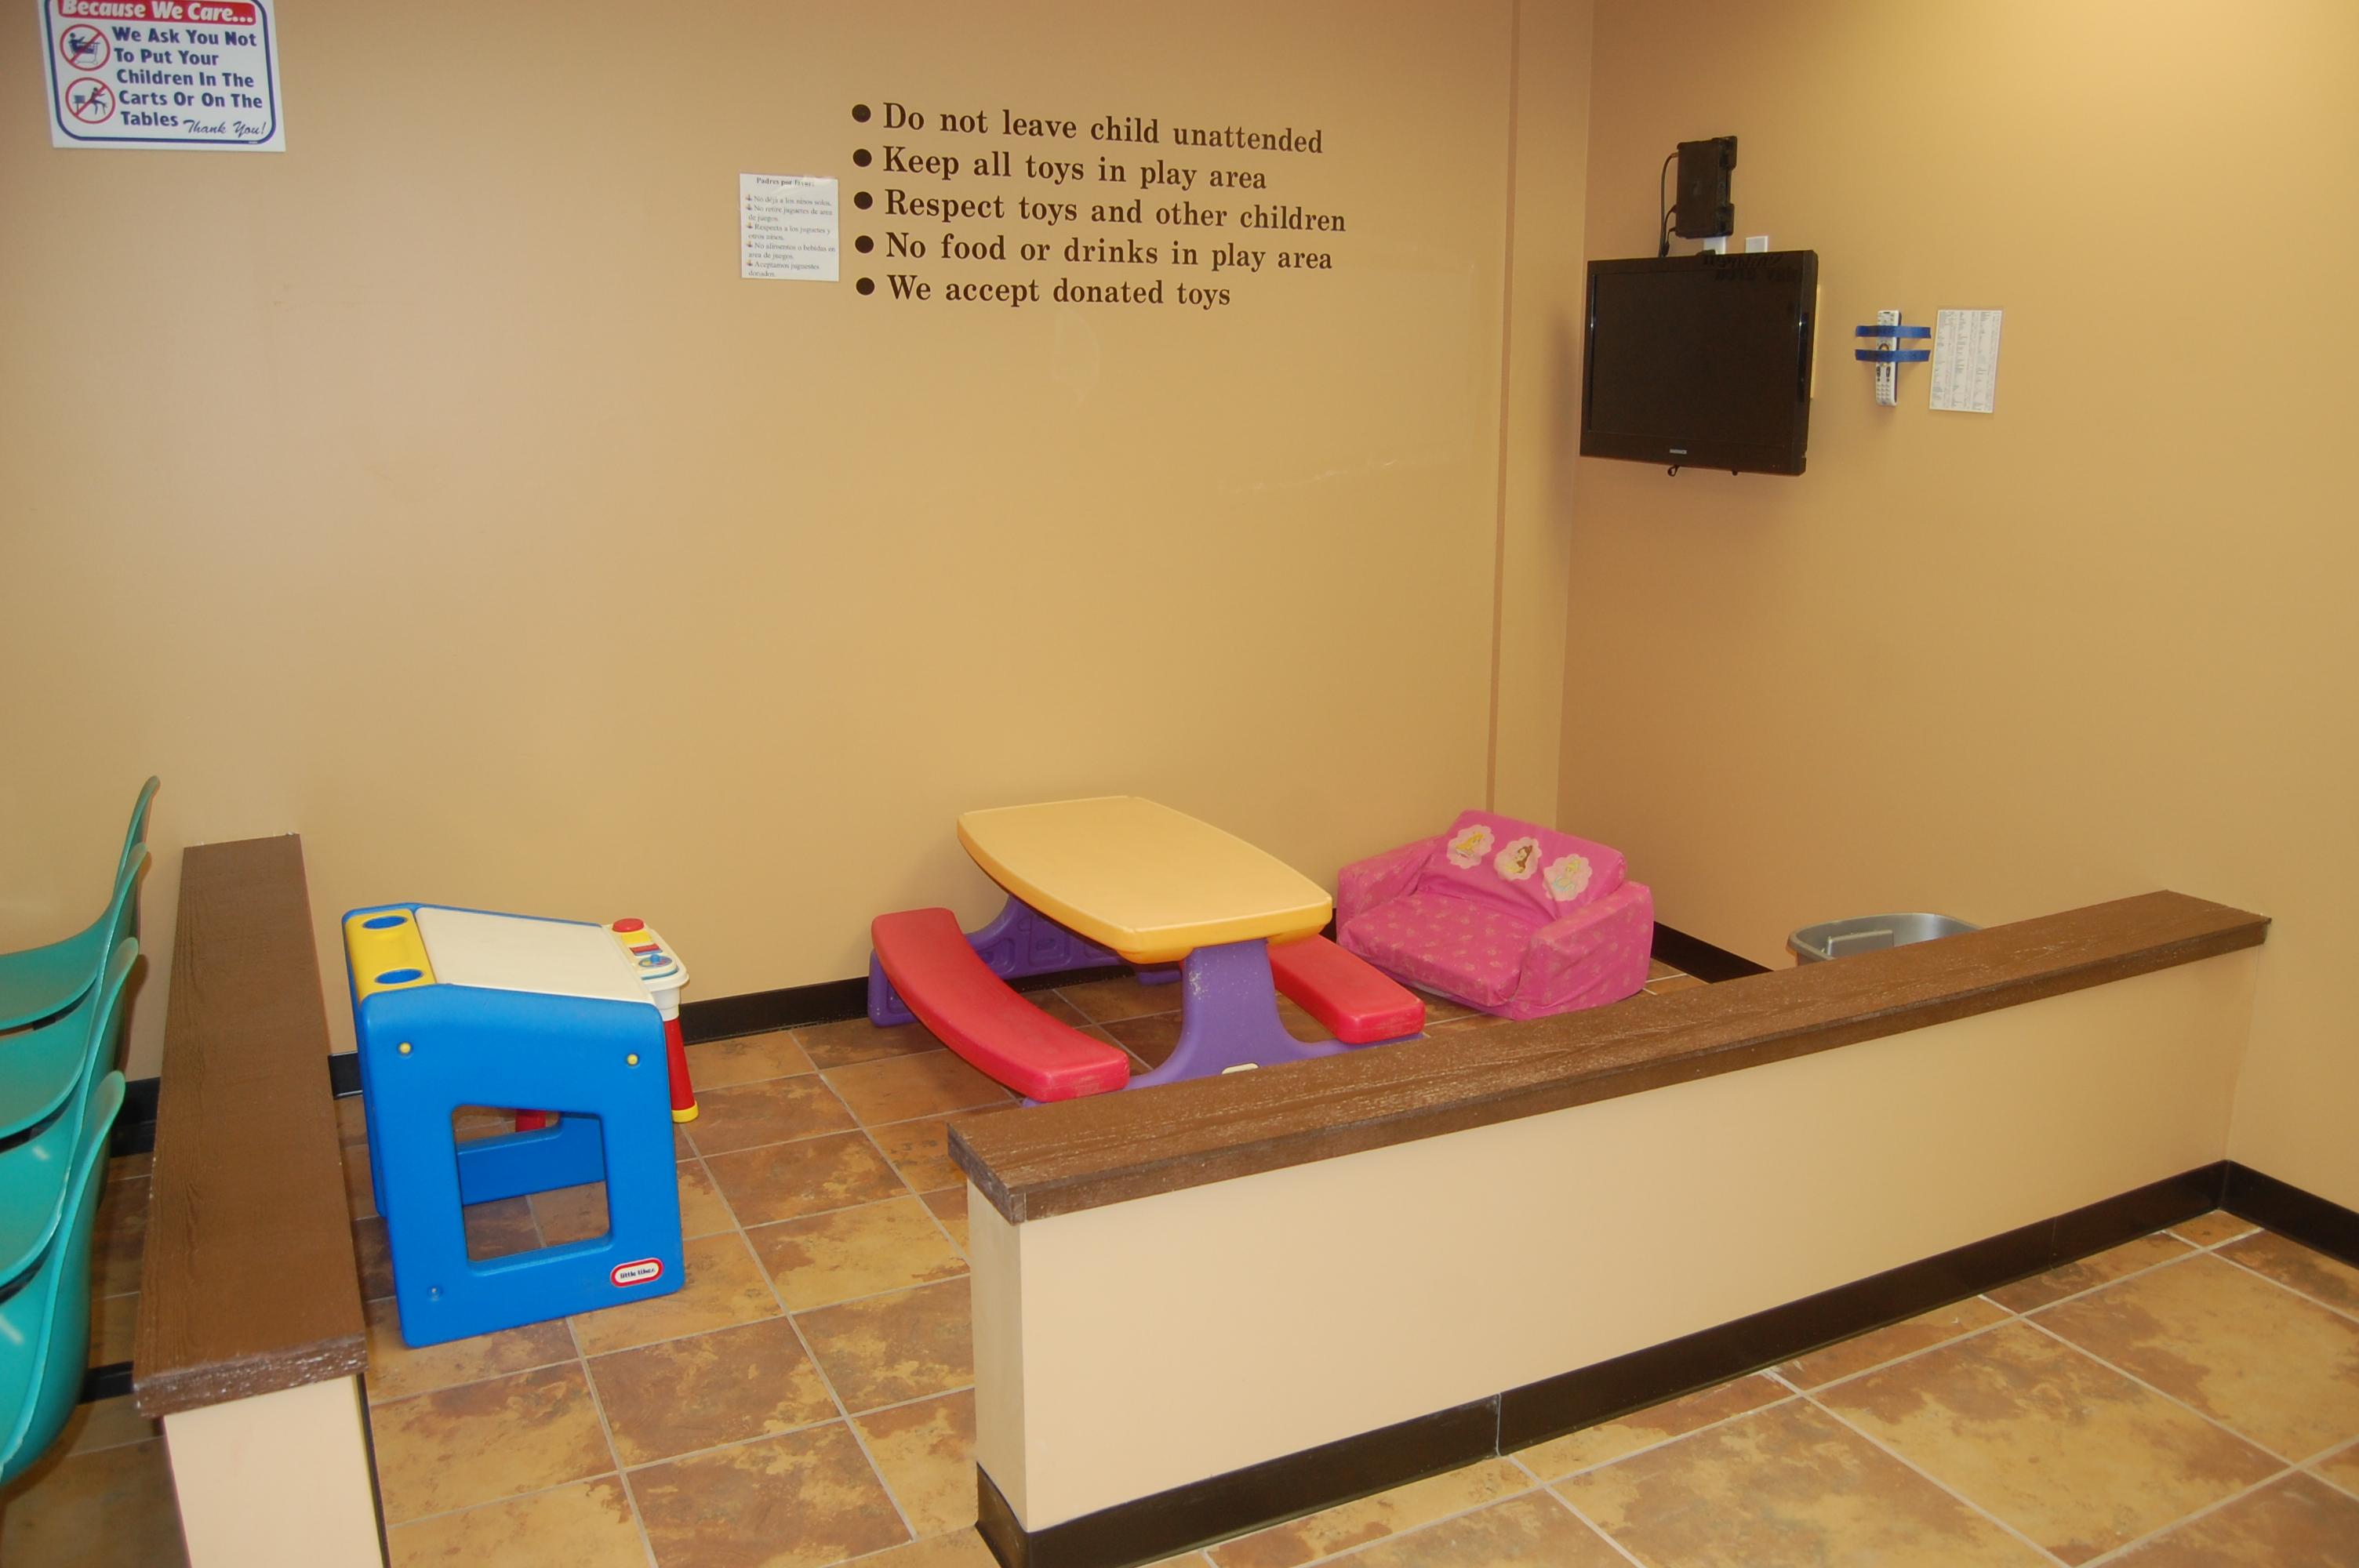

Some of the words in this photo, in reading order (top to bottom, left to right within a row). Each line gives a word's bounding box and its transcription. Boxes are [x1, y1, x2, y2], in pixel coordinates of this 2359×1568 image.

[62, 0, 146, 17] Because
[151, 2, 183, 20] We
[187, 2, 253, 23] Care...
[112, 27, 141, 42] We
[148, 28, 180, 43] Ask
[186, 30, 219, 45] You
[225, 31, 256, 46] Not
[114, 48, 134, 62] To
[140, 49, 173, 64] Put
[178, 50, 219, 65] Your
[117, 69, 194, 85] Children
[199, 72, 216, 86] In
[222, 73, 254, 87] The
[118, 90, 167, 106] Carts
[173, 92, 194, 106] Or
[202, 93, 225, 107] On
[231, 93, 263, 108] The
[121, 111, 179, 126] Tables
[183, 119, 226, 133] Thank
[233, 121, 267, 138] You!
[884, 103, 924, 129] Do
[940, 111, 987, 133] not
[1003, 110, 1076, 138] leave
[1091, 116, 1159, 143] child
[1173, 126, 1322, 153] unattended
[883, 146, 958, 180] Keep
[974, 151, 1011, 176] all
[1026, 155, 1083, 184] toys
[1099, 157, 1125, 182] in
[1140, 160, 1197, 191] play
[1210, 171, 1266, 188] area
[885, 189, 1004, 223] Respect
[1019, 197, 1077, 226] toys
[1092, 199, 1142, 223] and
[1157, 201, 1227, 226] other
[1241, 205, 1345, 231] children
[886, 232, 925, 258] No
[941, 234, 1005, 260] food
[1021, 244, 1050, 260] or
[1064, 238, 1157, 263] drinks
[1172, 241, 1198, 264] in
[1212, 243, 1266, 272] play
[1278, 252, 1332, 269] area
[887, 275, 930, 299] We
[947, 280, 1039, 307] accept
[1053, 278, 1163, 303] donated
[1177, 283, 1230, 310] toys
